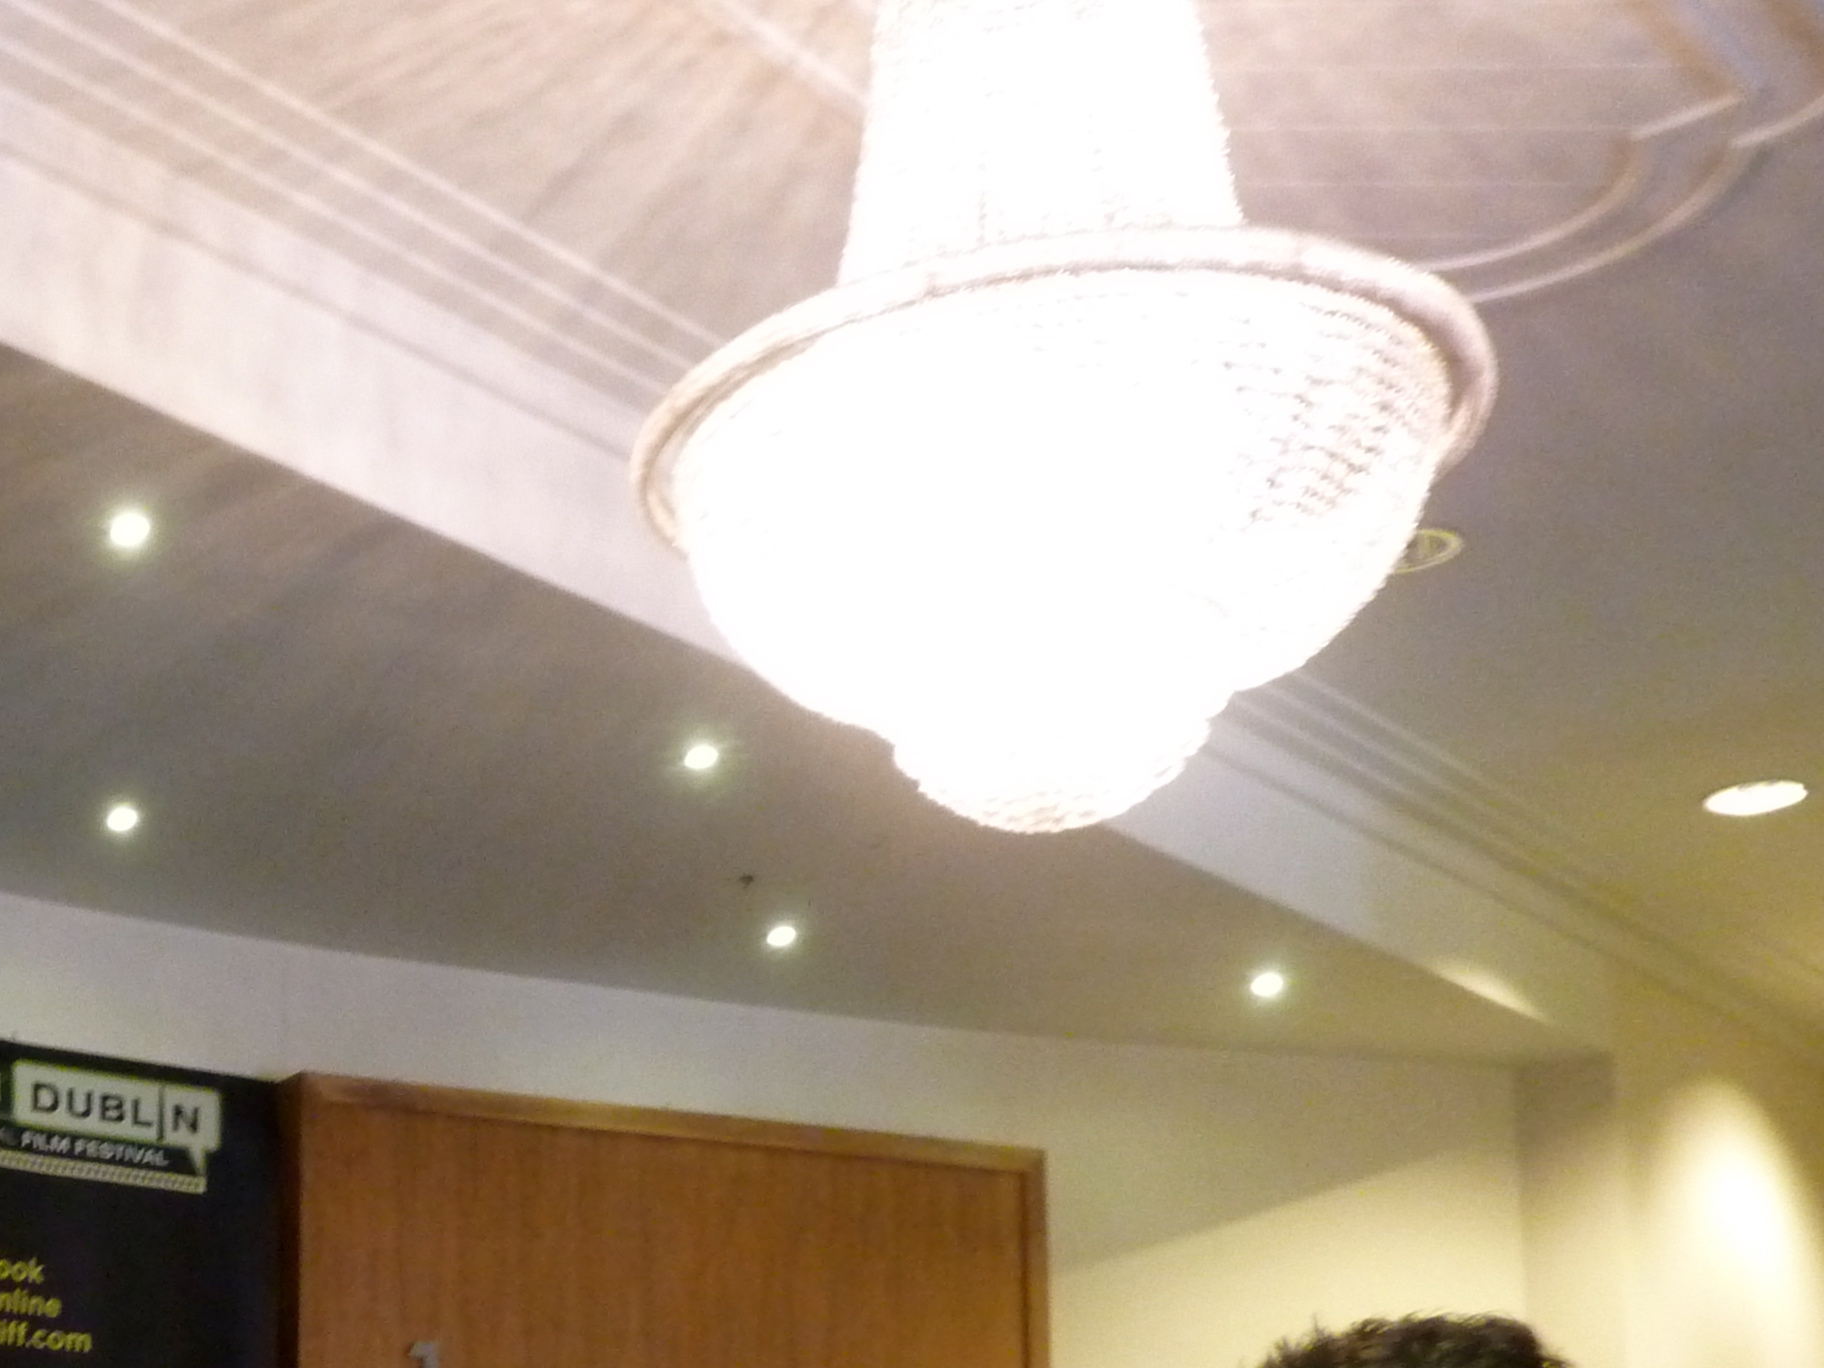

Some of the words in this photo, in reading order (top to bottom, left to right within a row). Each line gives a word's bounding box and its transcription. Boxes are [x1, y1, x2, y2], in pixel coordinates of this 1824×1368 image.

[31, 1080, 202, 1143] DUBLIN
[20, 1131, 71, 1155] FILM
[74, 1138, 171, 1168] FESTIVAL
